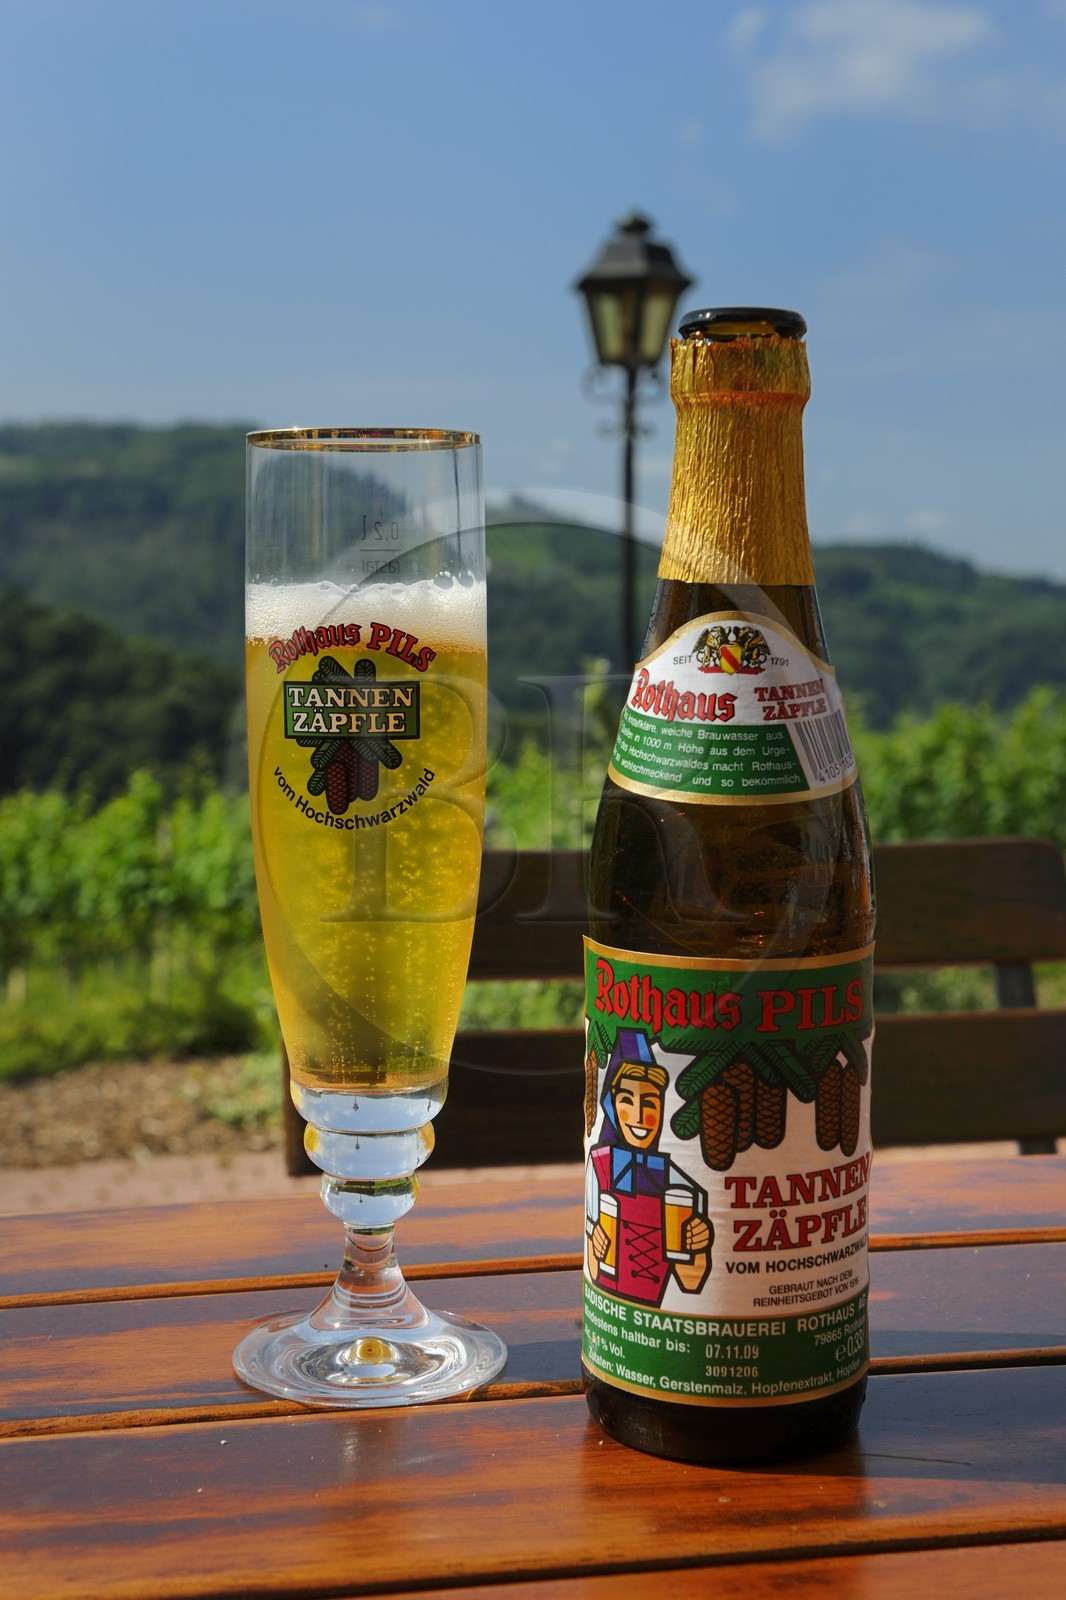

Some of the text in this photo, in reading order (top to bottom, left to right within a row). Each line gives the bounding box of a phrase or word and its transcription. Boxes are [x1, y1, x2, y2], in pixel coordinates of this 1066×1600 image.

[269, 622, 436, 674] Rothaus PILS
[673, 655, 693, 665] SEIT
[770, 657, 789, 667] 1791
[288, 687, 414, 708] TANNEN
[631, 667, 738, 723] Rothaus
[754, 678, 825, 702] TANNEN
[292, 708, 406, 733] ZÄPFLE
[762, 700, 828, 721] ZÄPFLE
[661, 726, 693, 738] weiche
[697, 729, 759, 741] Brauwasser
[766, 732, 784, 740] aus
[628, 746, 709, 770] Hochschwarzwaldes
[712, 761, 744, 771] macht
[752, 761, 796, 771] Rothaus-
[643, 736, 662, 749] 1000
[663, 742, 672, 750] m
[678, 742, 704, 755] Höhe
[709, 748, 728, 756] aus
[733, 746, 755, 756] dem
[762, 747, 790, 757] Urge-
[621, 758, 682, 782] wohlschmeckend
[692, 777, 712, 786] und
[721, 778, 734, 787] so
[273, 766, 436, 831] vom Hochschwarzwald
[594, 957, 865, 1034] Rothaus PILS
[724, 1152, 870, 1209] TANNEN
[733, 1195, 867, 1252] ZÄPFLE
[726, 1261, 760, 1275] VOM
[769, 1268, 853, 1295] GEBRAUT NACH DEM
[753, 1288, 833, 1307] REINHEITSGEBOT
[835, 1282, 849, 1295] VON
[584, 1283, 867, 1337] BADISCHE STAATSBRAUEREI ROTHAUS AG
[584, 1303, 690, 1353] Mindestens haltbar bis:
[814, 1314, 866, 1347] 79865 Rothaus
[609, 1341, 626, 1359] Vol.
[705, 1343, 759, 1360] 07.11.09
[616, 1363, 656, 1388] Wasser,
[659, 1377, 747, 1396] Gerstenmalz,
[751, 1372, 835, 1397] Hopfenextrakt,
[705, 1365, 759, 1378] 3091206
